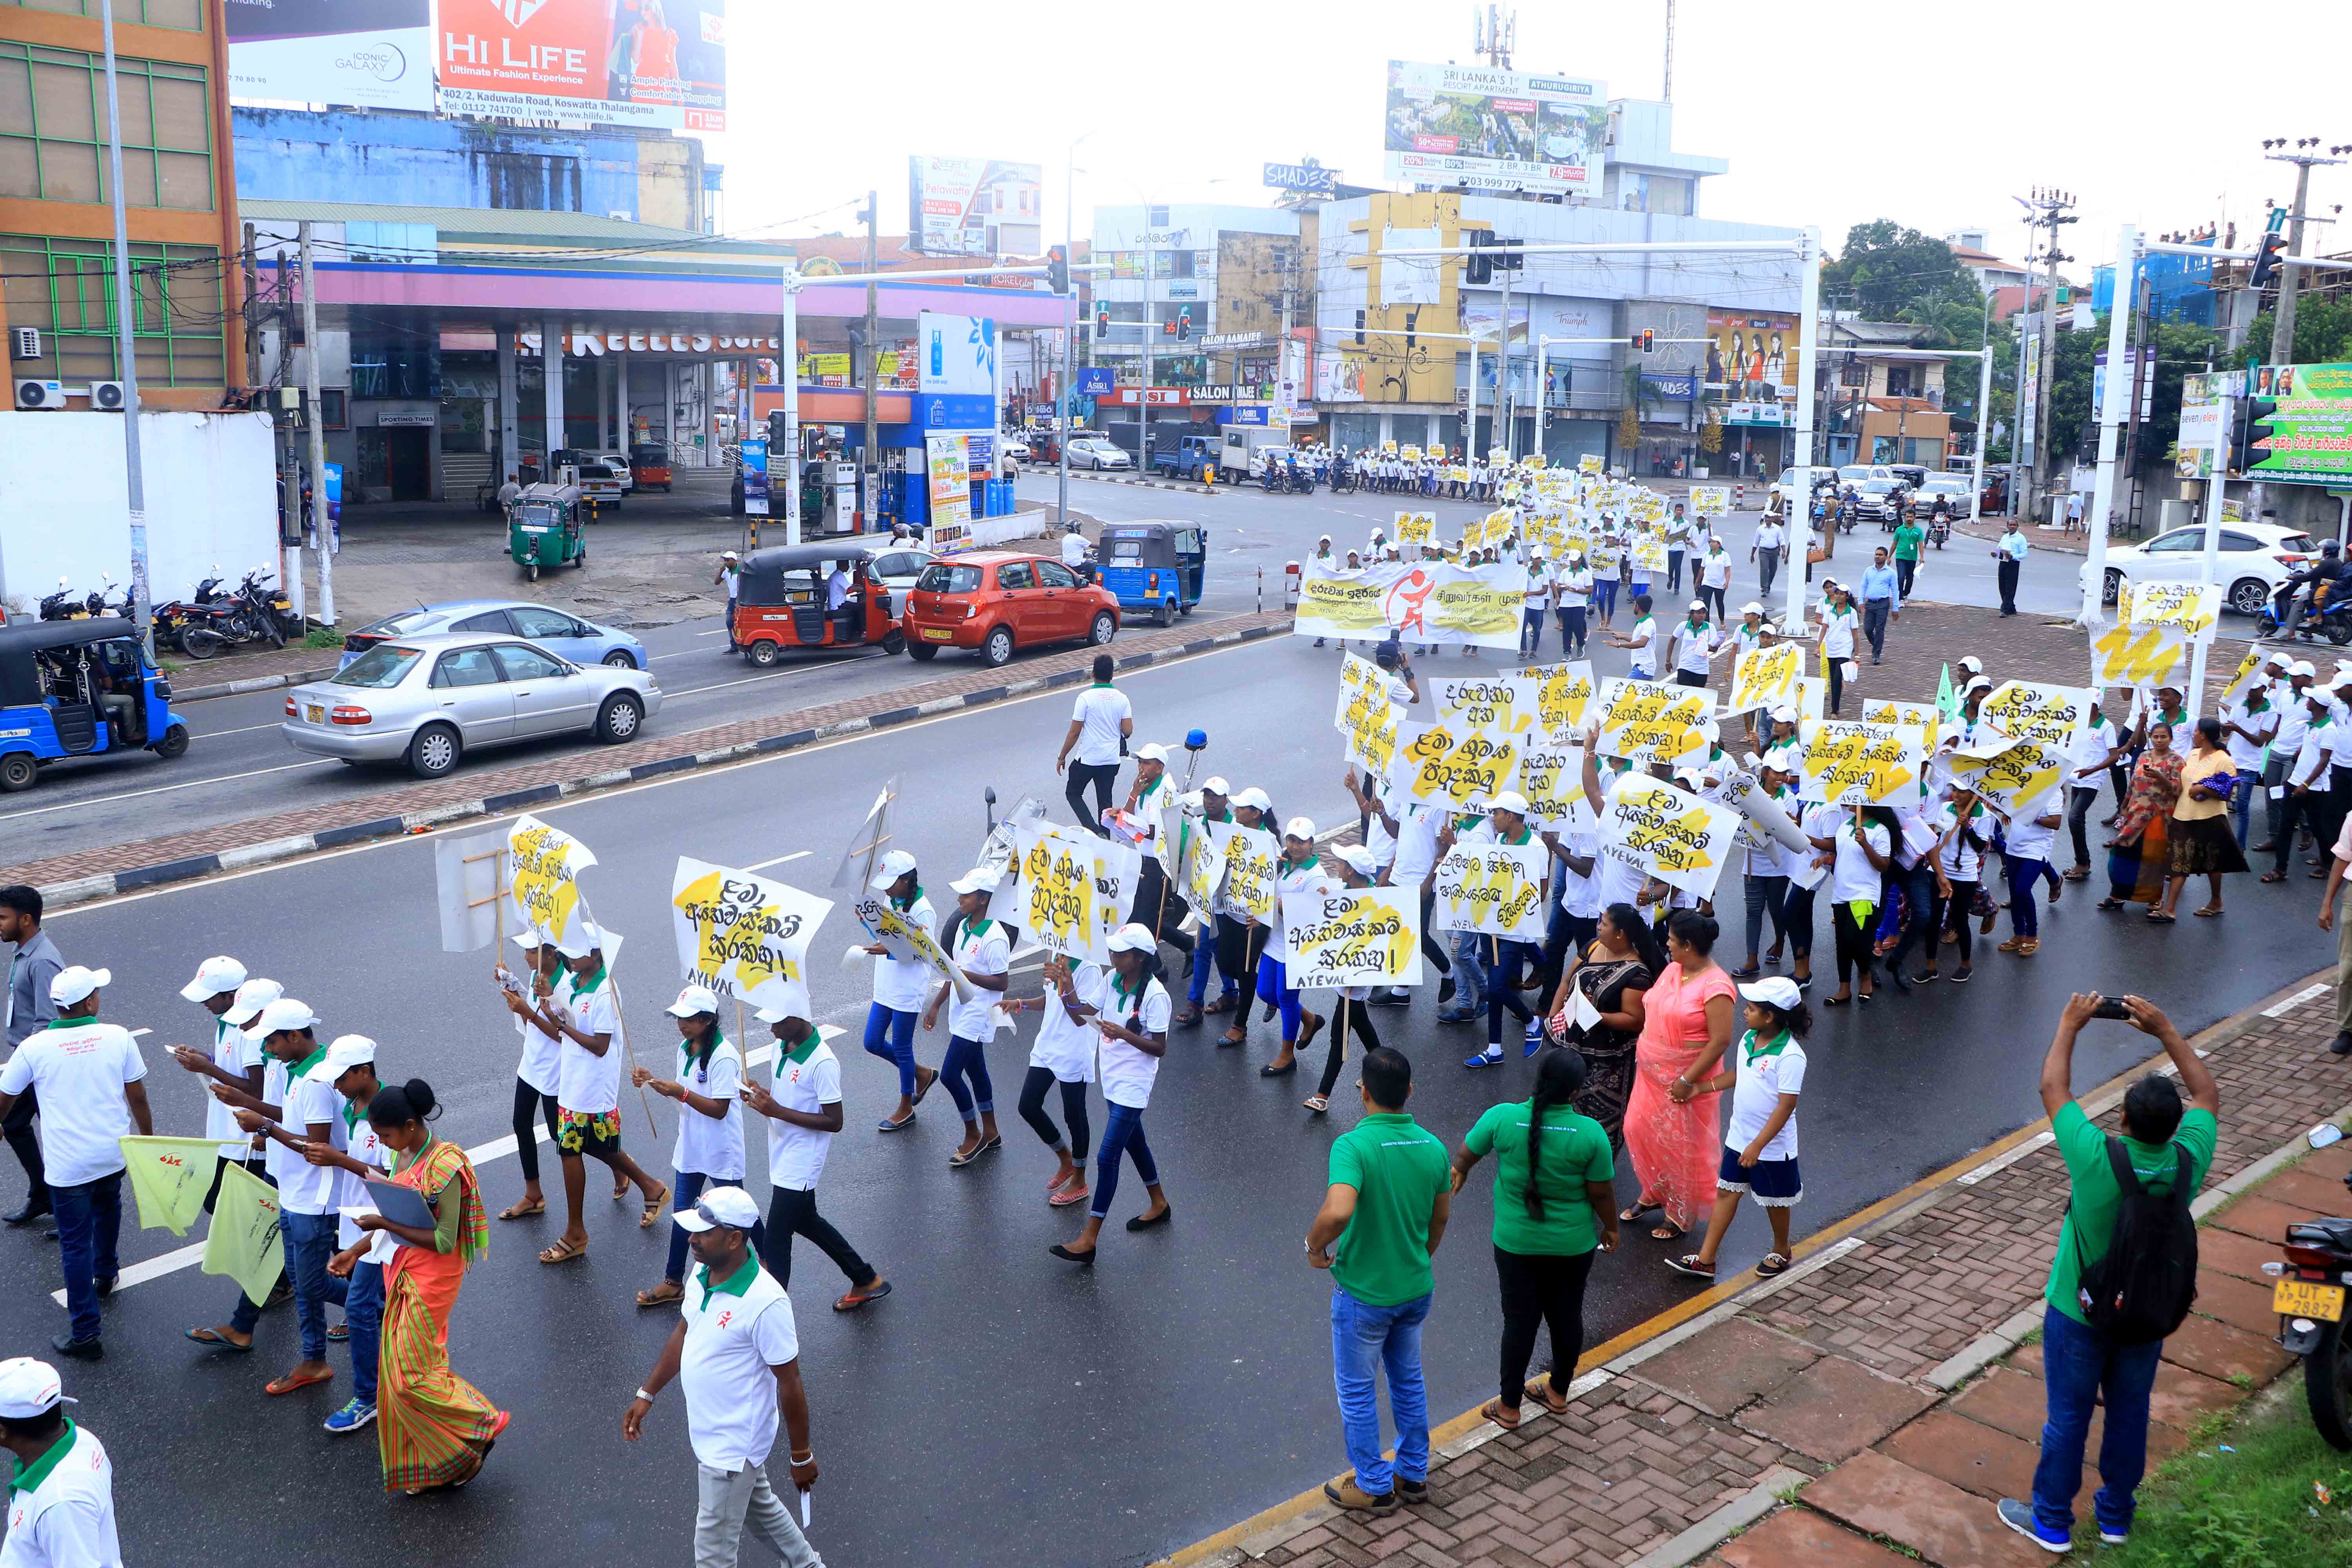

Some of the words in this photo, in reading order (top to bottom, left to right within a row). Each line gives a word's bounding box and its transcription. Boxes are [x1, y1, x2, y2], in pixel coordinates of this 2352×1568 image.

[354, 52, 388, 62] ICONIC
[445, 32, 489, 64] HI
[502, 38, 587, 74] LIFE
[335, 58, 387, 73] GALAXY
[450, 65, 491, 76] Ultimate
[494, 69, 530, 80] Fashion
[532, 72, 584, 84] Experience
[1444, 71, 1459, 81] SRI
[1462, 72, 1505, 85] LANKA'S
[631, 76, 658, 86] Ample
[659, 79, 691, 90] Parking
[1443, 81, 1471, 91] RESORT
[1474, 84, 1519, 95] APARTMENT
[1531, 81, 1590, 93] ATHURUGIRIYA
[443, 89, 474, 102] 402/2,
[477, 92, 523, 104] Kaduwala
[526, 96, 552, 107] Road,
[555, 99, 597, 110] Koswatta
[600, 103, 654, 114] Thalangama
[630, 88, 681, 100] Comfortable
[683, 94, 721, 105] Shopping
[444, 102, 459, 110] Tel:
[462, 103, 485, 112] 0112
[489, 105, 522, 115] 741700
[560, 111, 614, 122] www.hilife.lk
[1418, 138, 1431, 146] 50+
[1405, 157, 1422, 165] 20%
[1446, 160, 1463, 169] 80%
[1266, 165, 1330, 188] SHADES
[1459, 177, 1482, 186] 0703
[1485, 178, 1502, 187] 999
[1505, 180, 1522, 189] 777
[1553, 311, 1588, 329] Triumph
[1201, 335, 1225, 345] SALON
[1226, 332, 1261, 343] AAMAJEE
[1193, 386, 1230, 399] SALON
[2182, 414, 2198, 423] seven
[953, 462, 964, 471] 2018
[1310, 584, 1344, 597] දරුවන්
[1437, 590, 1491, 604] சிறுவர்கள்
[1499, 594, 1521, 606] முன்
[1414, 733, 1454, 756] ළමා
[1633, 751, 1675, 766] AYEVAC
[1961, 772, 2007, 806] AYEVAC
[1840, 794, 1878, 804] AYEVAC
[1602, 844, 1648, 871] AYEVAC
[720, 879, 766, 906] ළමා
[1323, 897, 1358, 918] ළමා
[1452, 920, 1480, 930] AYEVAC
[1037, 931, 1069, 951] AYEVAC
[688, 967, 735, 997] AYEVAC
[1297, 975, 1349, 987] AYEVAC
[2298, 1285, 2319, 1300] UT
[2293, 1301, 2330, 1318] 2882
